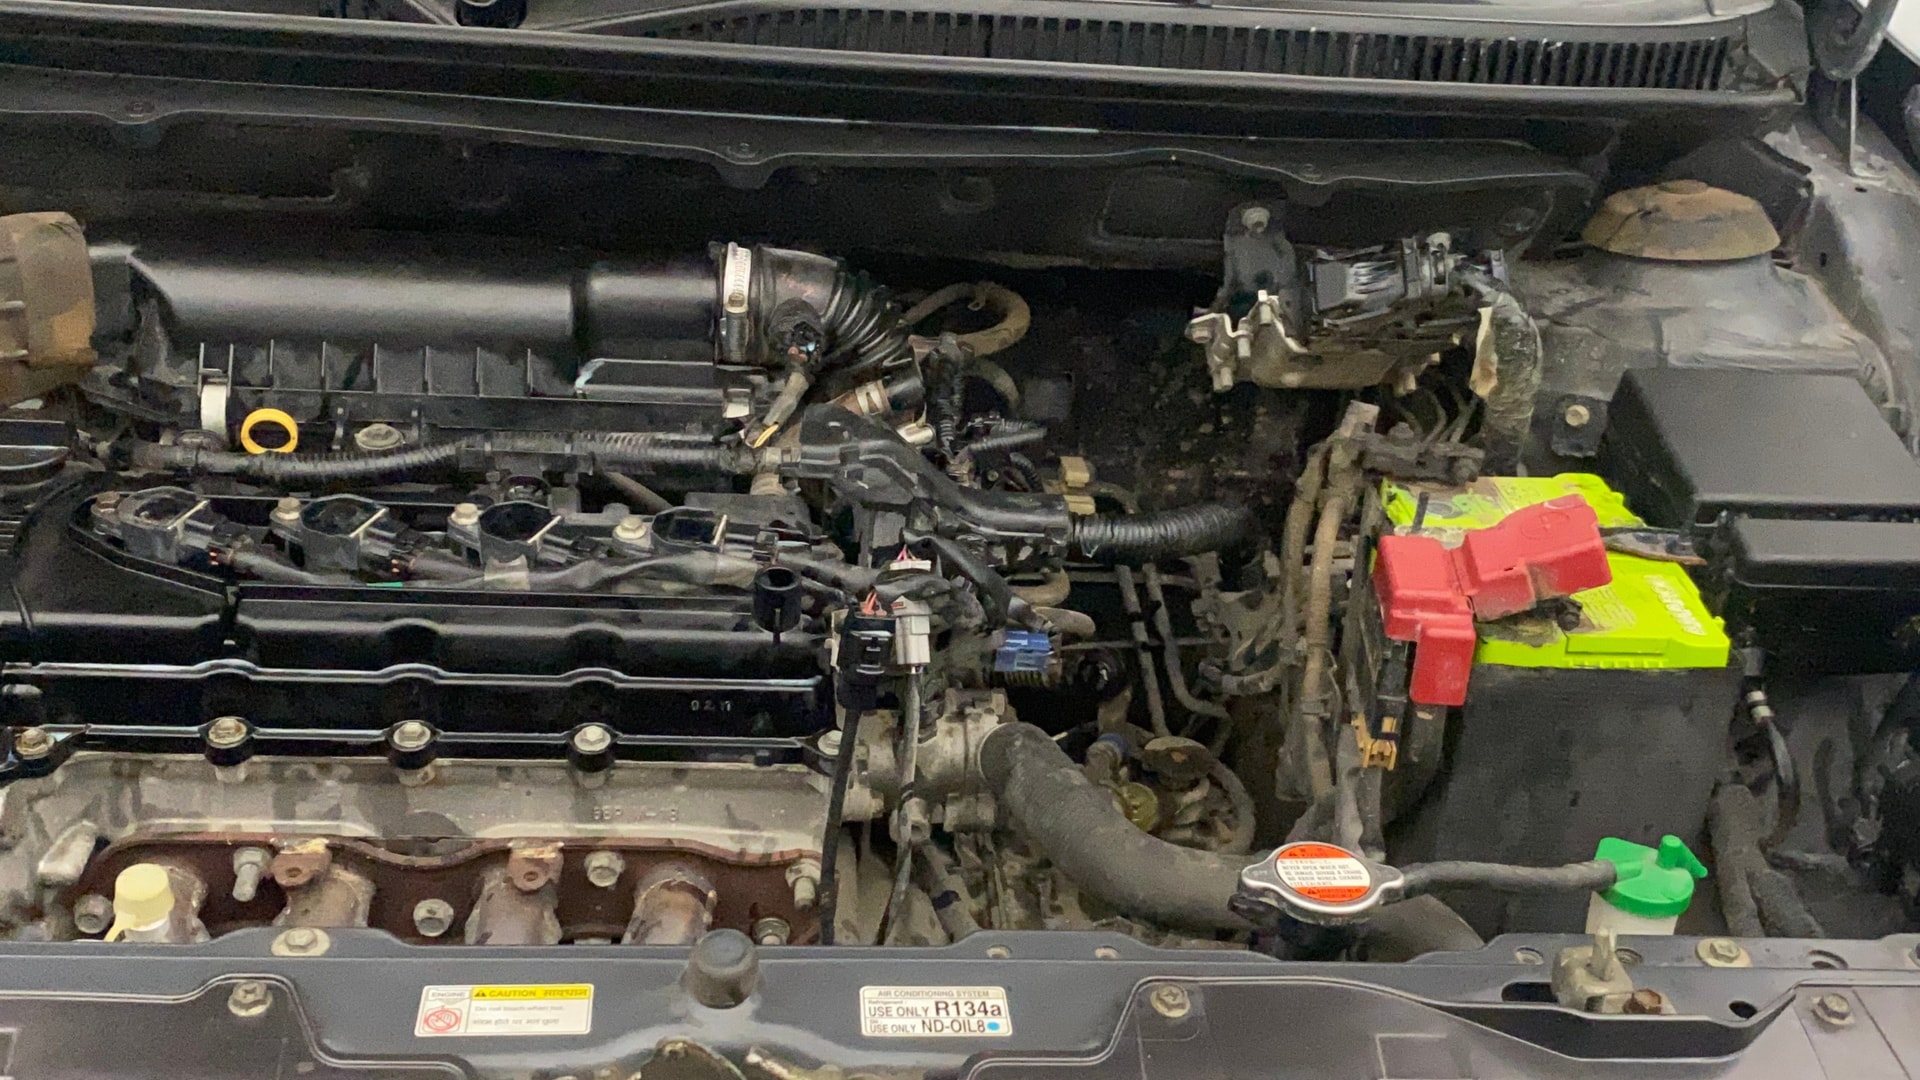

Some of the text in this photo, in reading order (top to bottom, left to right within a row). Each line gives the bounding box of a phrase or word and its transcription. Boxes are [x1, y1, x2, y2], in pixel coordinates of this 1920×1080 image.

[489, 990, 536, 998] CAUTION
[868, 1000, 1002, 1017] USE ONLY R134a
[870, 1019, 986, 1033] USE ONLY ND-OIL8
